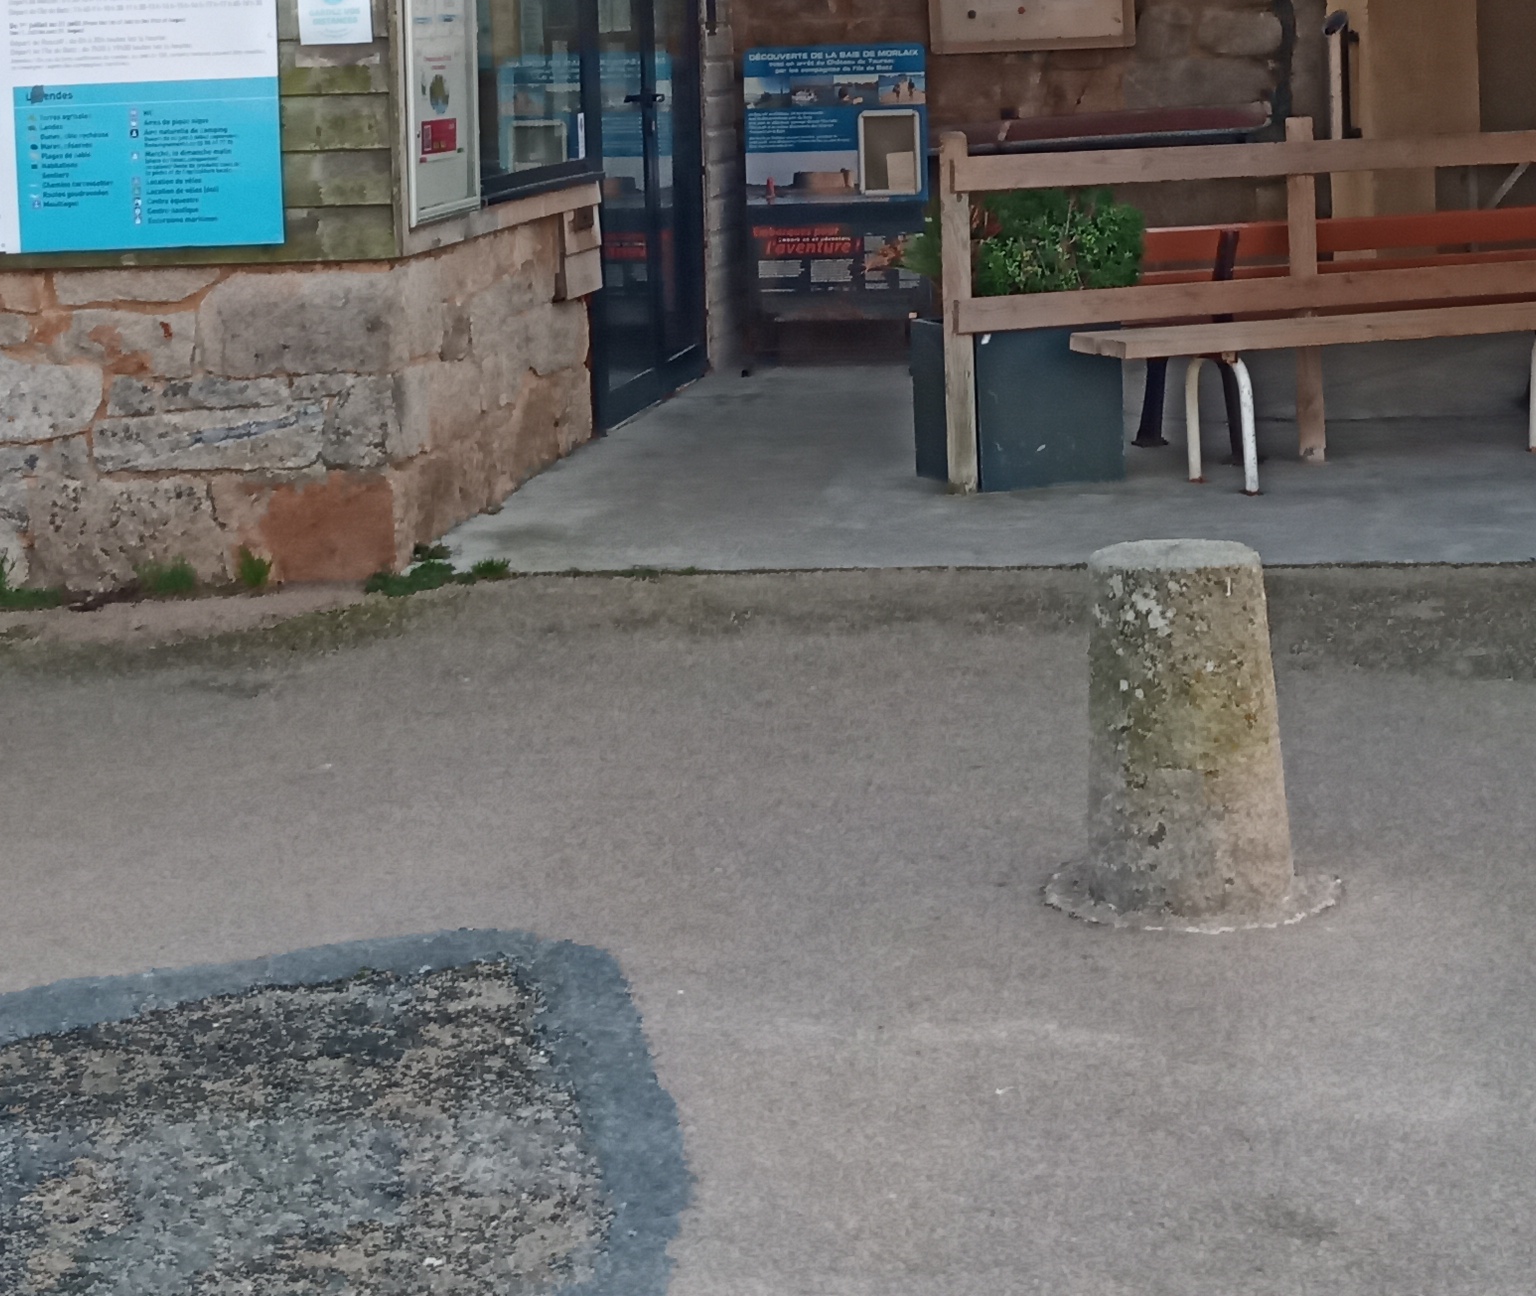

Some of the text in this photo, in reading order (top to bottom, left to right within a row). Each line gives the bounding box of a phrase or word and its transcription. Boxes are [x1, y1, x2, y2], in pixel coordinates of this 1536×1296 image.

[748, 51, 807, 62] DÉCOUVERTE
[810, 51, 823, 60] DE
[862, 50, 876, 58] DE
[877, 48, 918, 57] MORLAIX
[26, 91, 73, 102] Lendes
[766, 240, 852, 255] l'aventure
